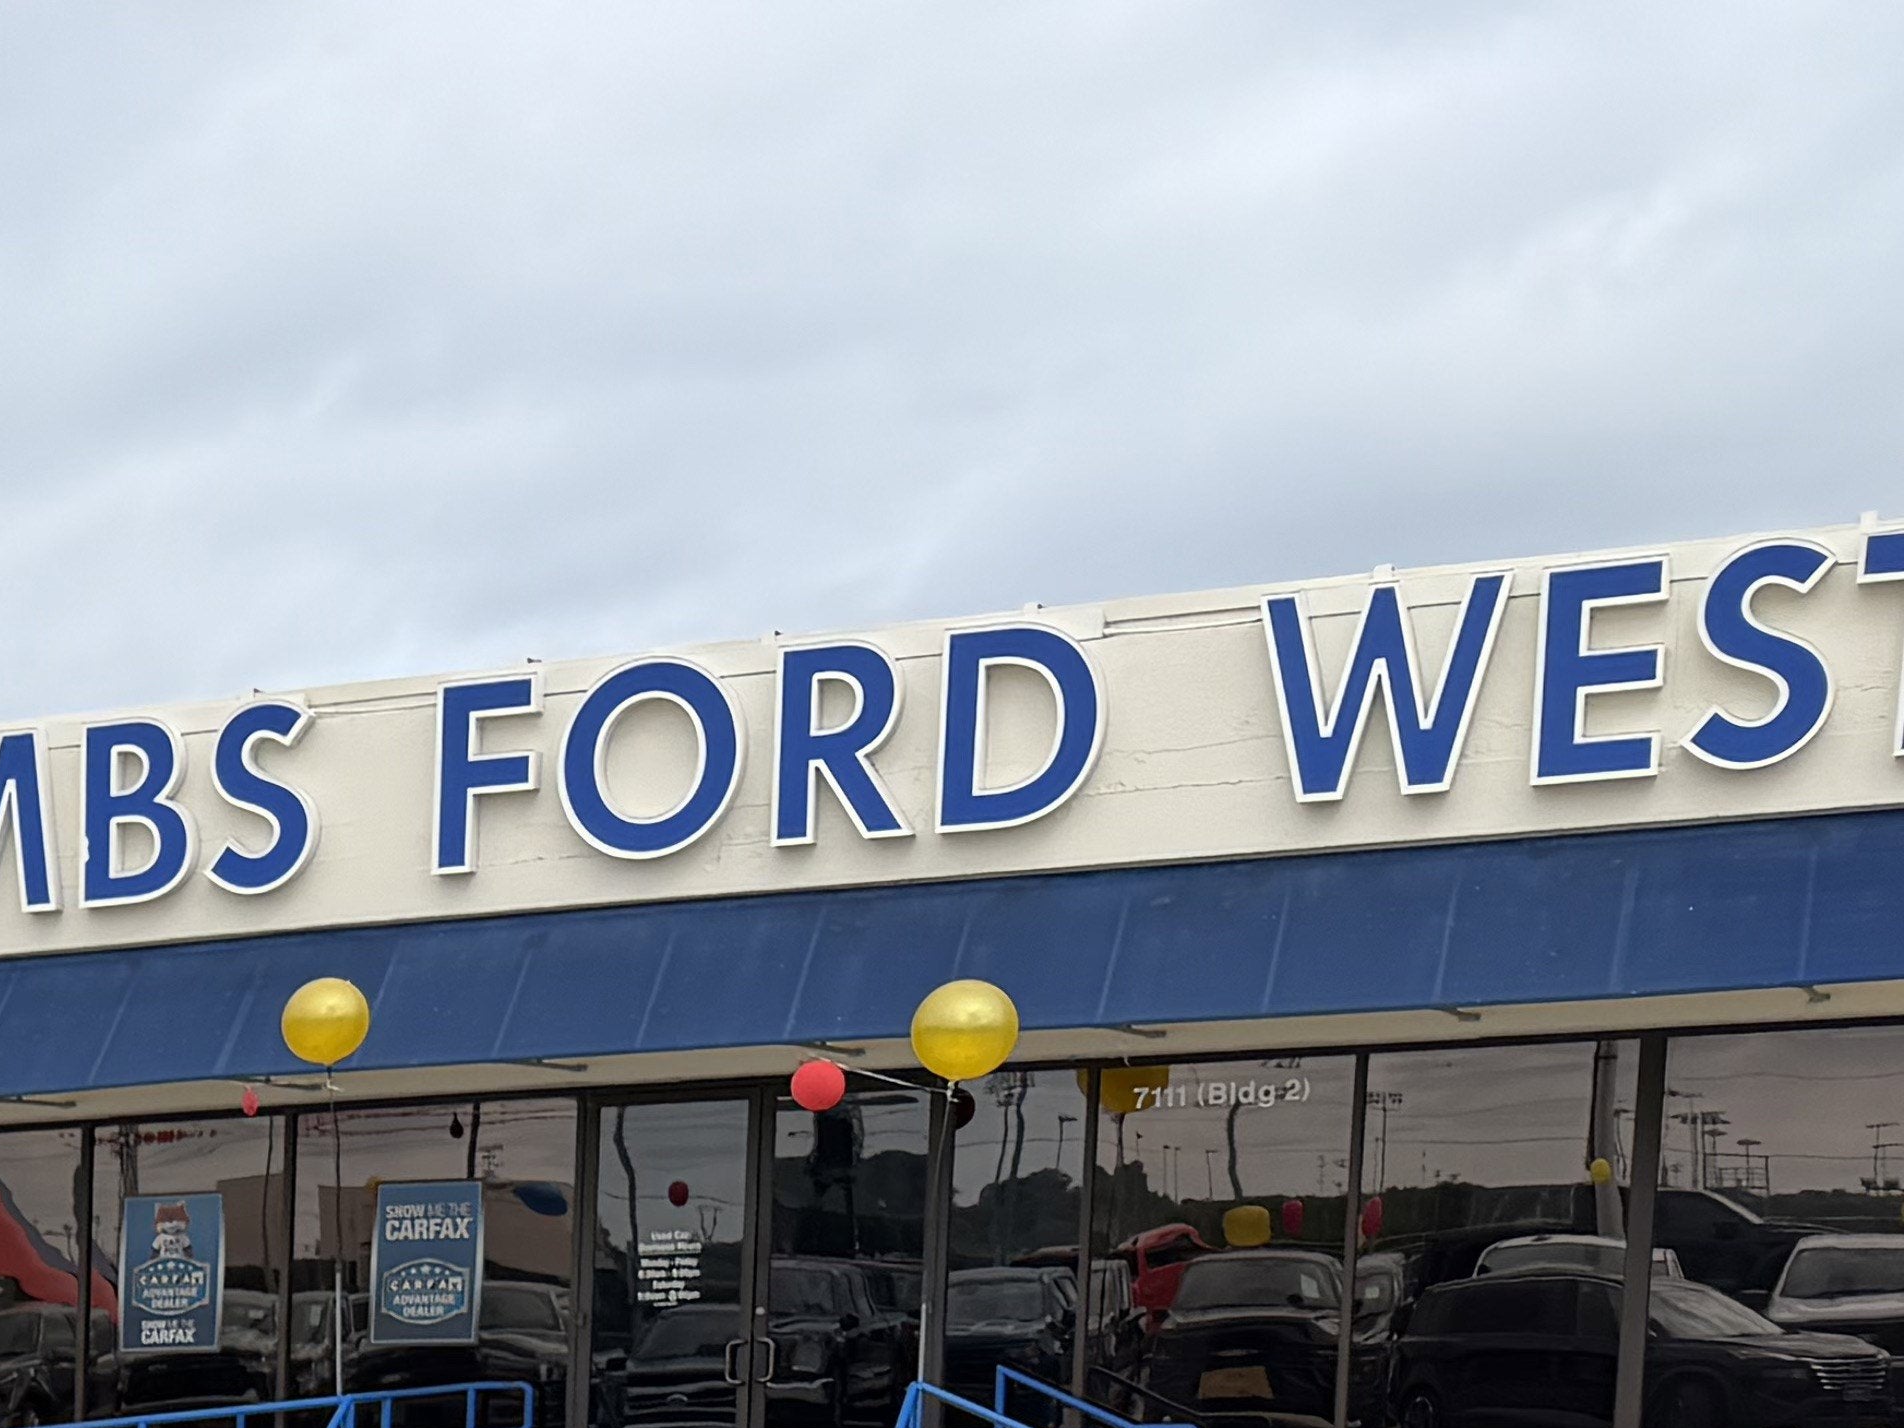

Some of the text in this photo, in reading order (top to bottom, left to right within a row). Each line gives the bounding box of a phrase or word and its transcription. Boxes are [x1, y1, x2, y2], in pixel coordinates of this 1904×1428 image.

[431, 621, 1104, 875] FORD
[1132, 1084, 1187, 1109] 7111
[1197, 1080, 1276, 1107] (Bldg
[385, 1204, 425, 1218] SHOW
[385, 1217, 472, 1241] CARFAX
